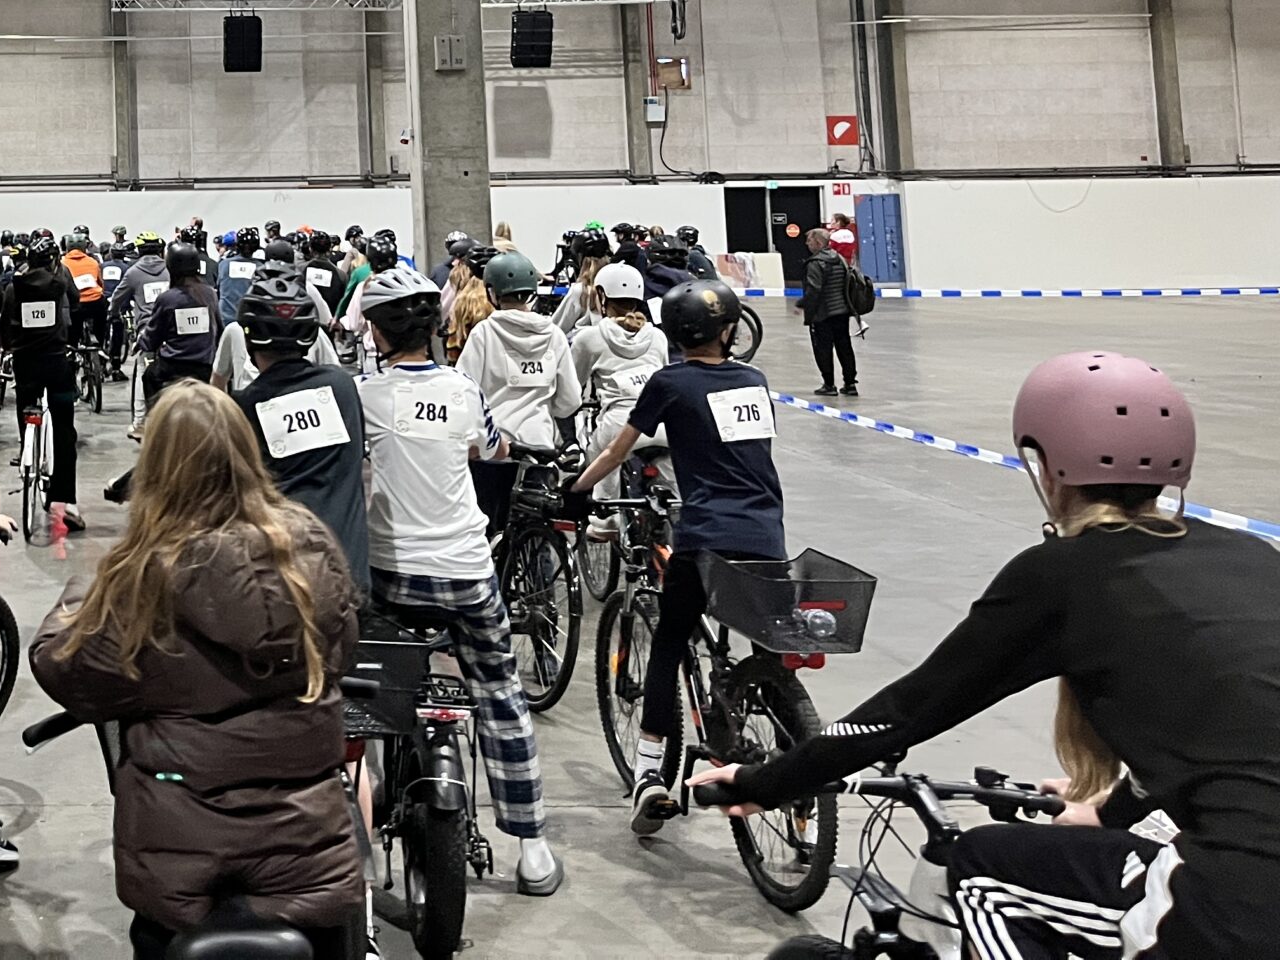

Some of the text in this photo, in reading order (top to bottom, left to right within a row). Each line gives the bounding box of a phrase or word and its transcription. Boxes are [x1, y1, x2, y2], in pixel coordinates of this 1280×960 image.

[31, 309, 46, 319] 126
[187, 315, 199, 325] 117
[520, 361, 544, 375] 234
[414, 401, 449, 424] 284
[733, 403, 761, 423] 276
[283, 408, 322, 435] 280
